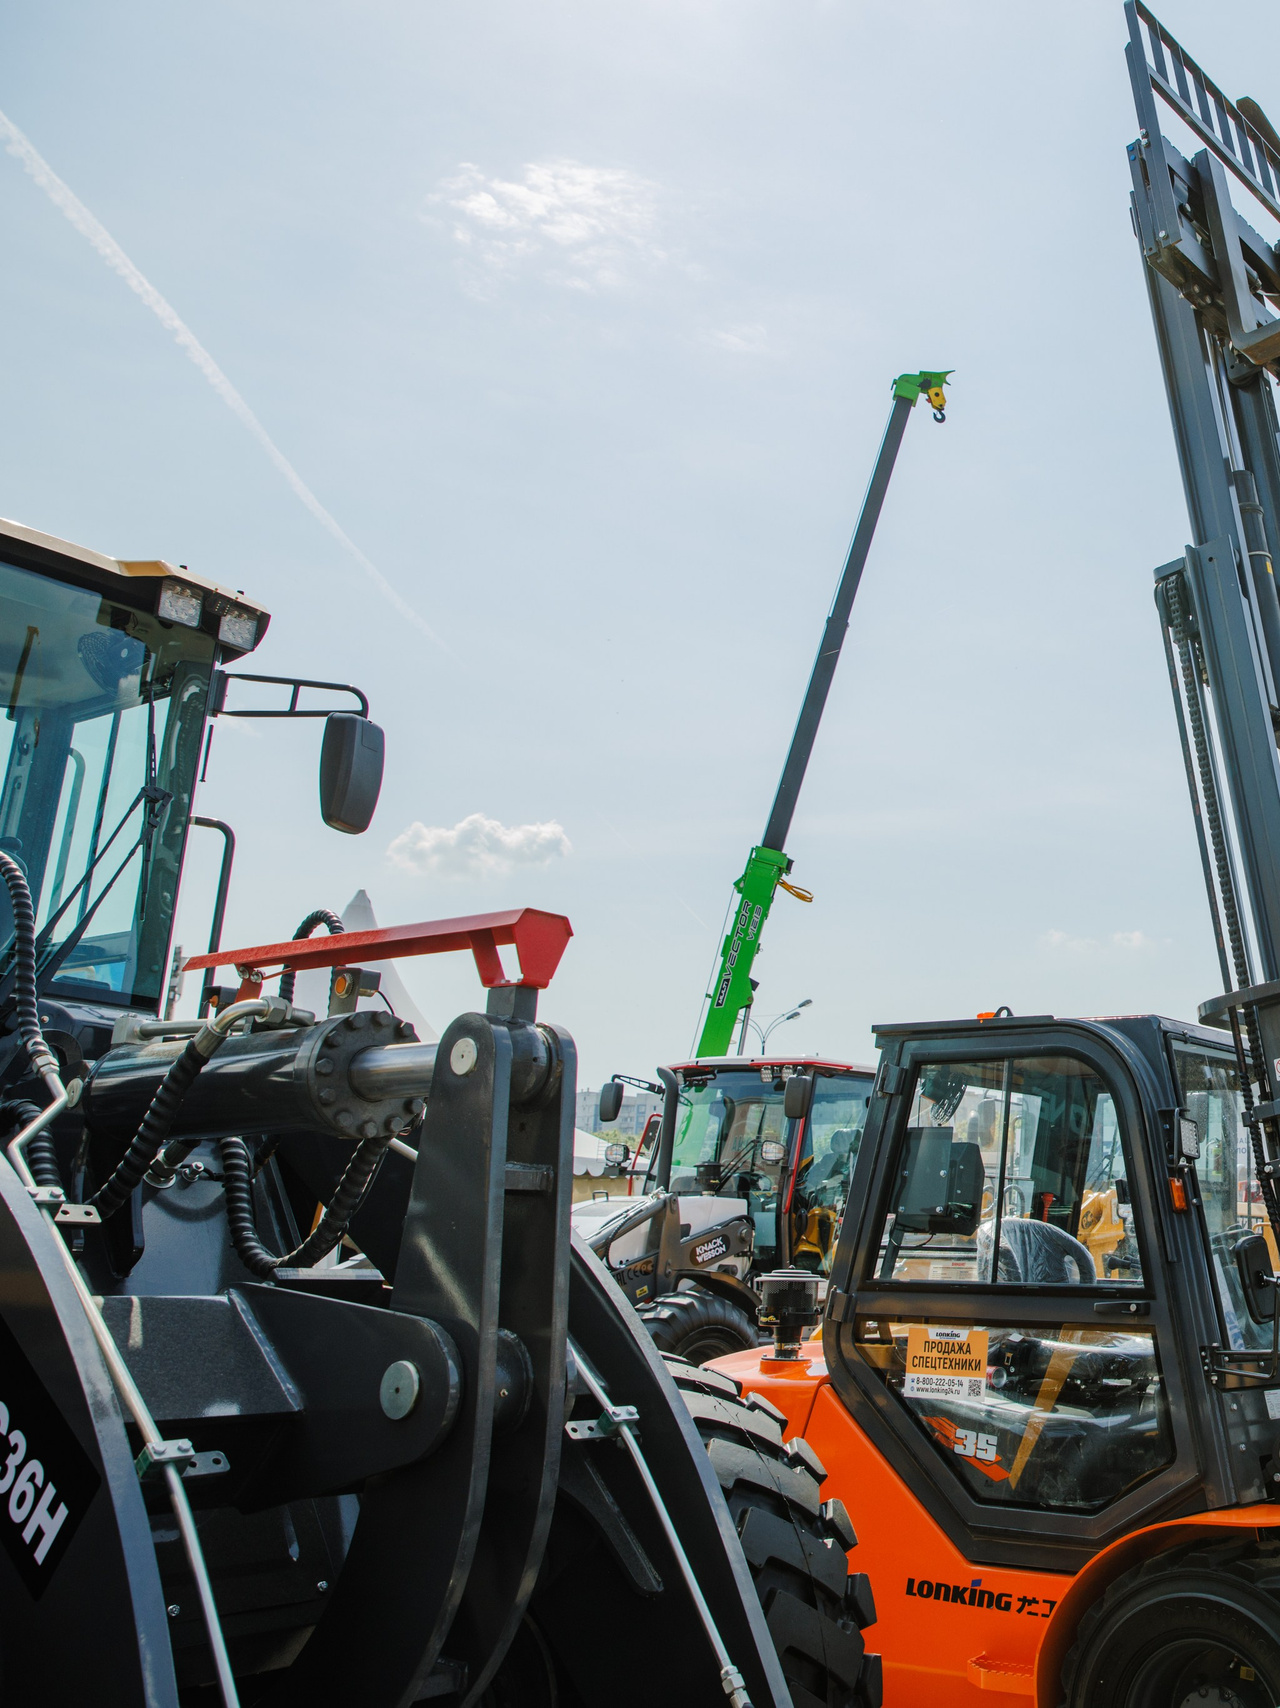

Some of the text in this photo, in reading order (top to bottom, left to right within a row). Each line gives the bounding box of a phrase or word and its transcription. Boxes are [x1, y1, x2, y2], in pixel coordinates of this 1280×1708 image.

[723, 899, 752, 977] VECTOR
[695, 1236, 724, 1256] KNACK
[696, 1244, 727, 1263] WESSON
[923, 1340, 971, 1355] ПРОДАЖА
[912, 1355, 981, 1372] СПЕЦТЕХНИКИ
[916, 1376, 964, 1388] 8-800-222-05-14
[916, 1385, 961, 1396] www.lonking24.ru
[953, 1428, 998, 1462] 35
[905, 1577, 1013, 1612] LONKING
